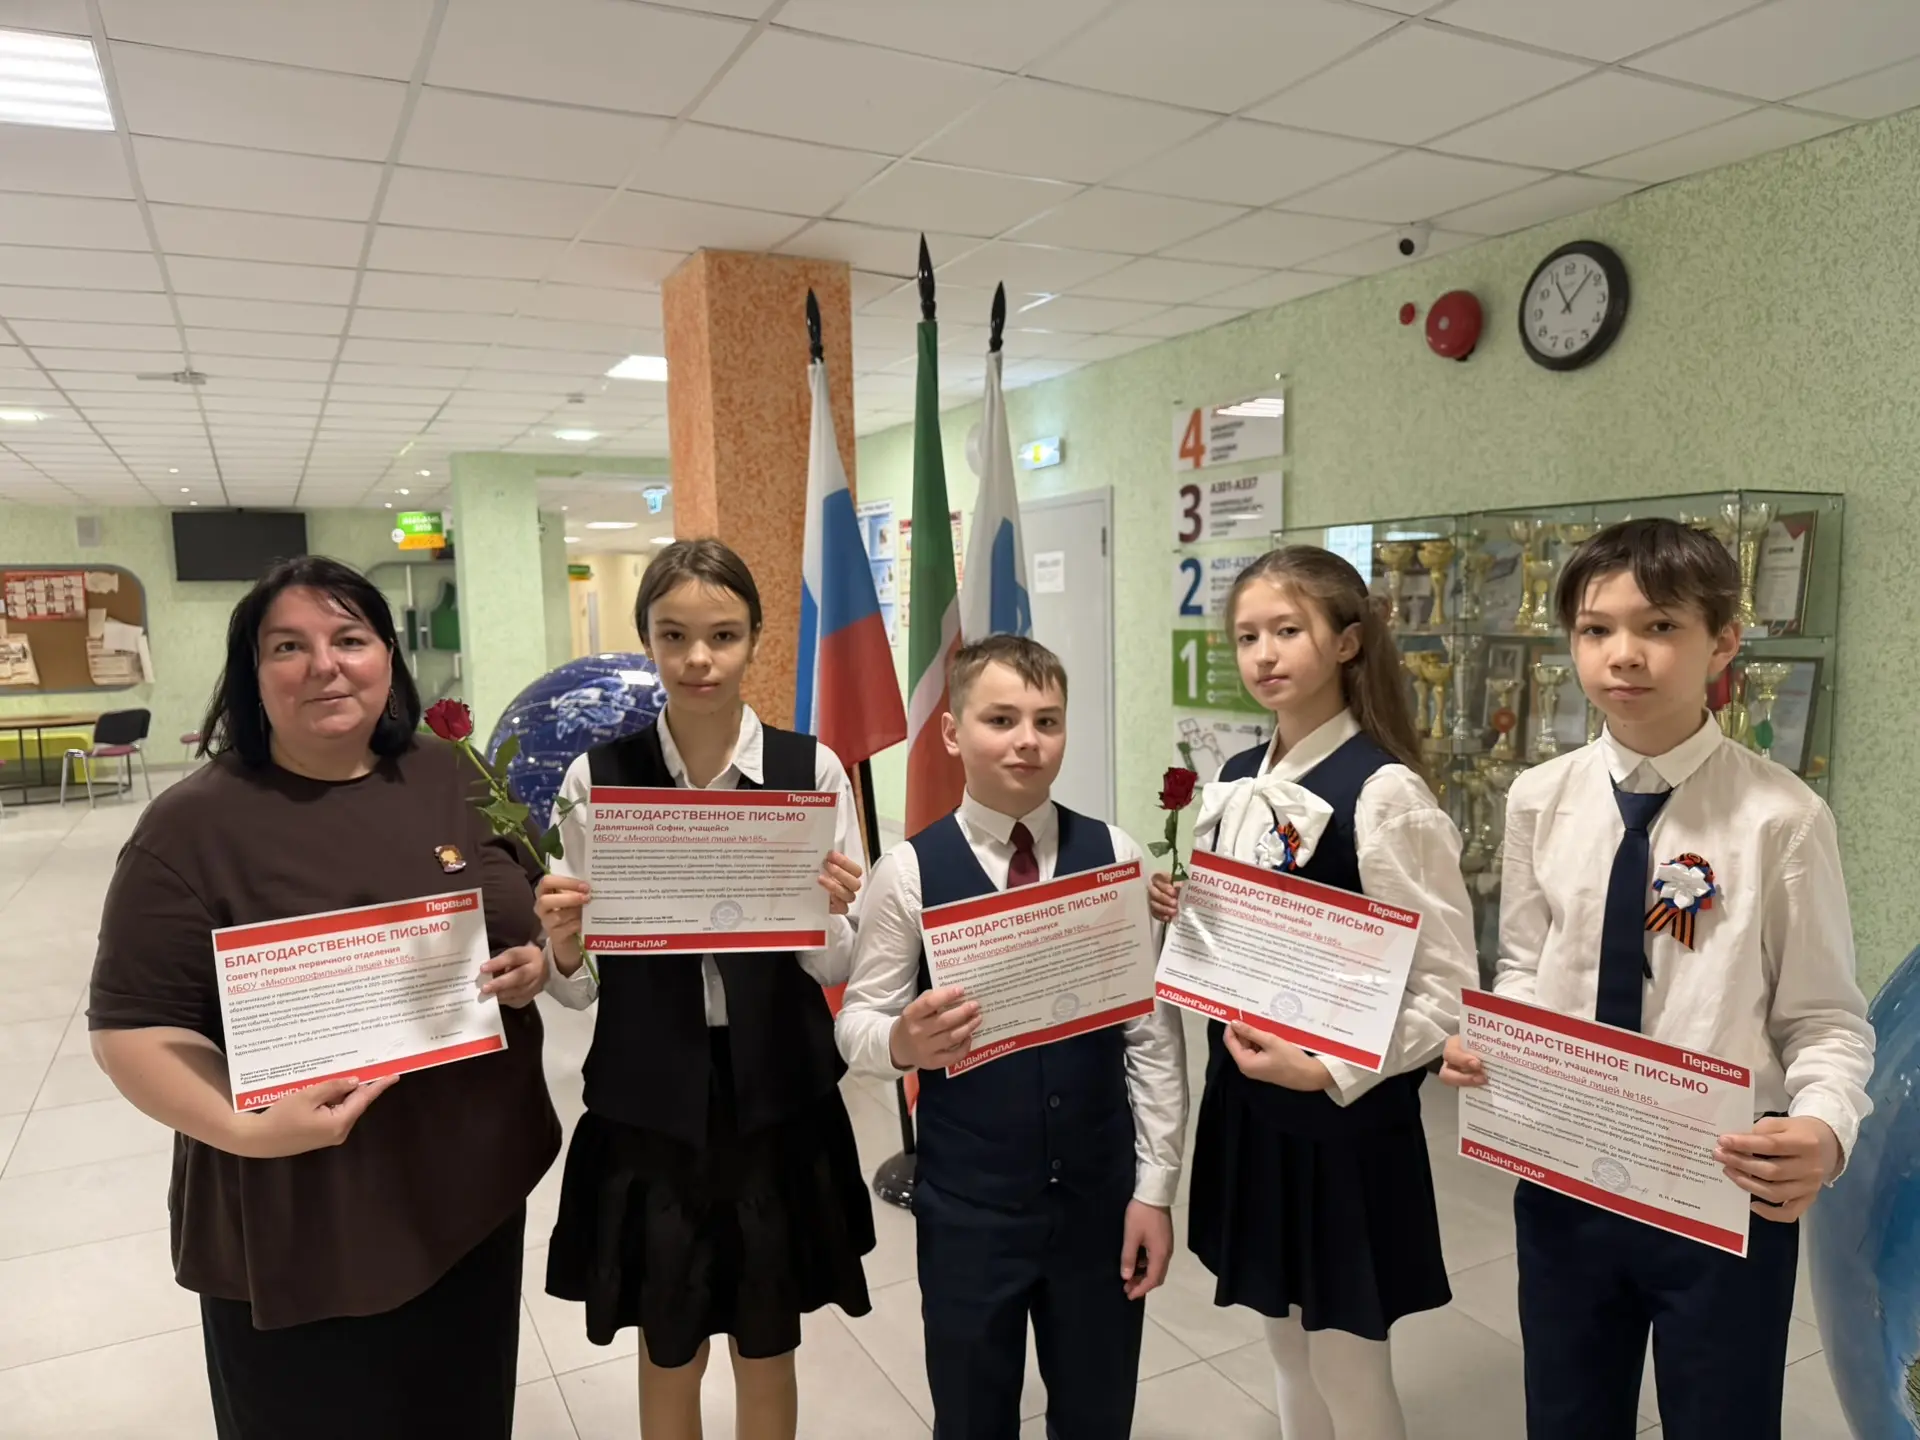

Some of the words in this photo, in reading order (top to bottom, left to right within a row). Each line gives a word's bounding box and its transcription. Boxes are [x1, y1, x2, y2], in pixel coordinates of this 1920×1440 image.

[1534, 308, 1544, 321] 9
[1538, 325, 1548, 338] 8
[1549, 335, 1559, 348] 7
[1564, 337, 1574, 350] 6
[1580, 329, 1589, 341] 5
[1179, 408, 1206, 469] 4
[1179, 484, 1202, 543] 3
[1180, 557, 1203, 616] 2
[1180, 638, 1198, 699] 1
[786, 793, 831, 804] Первые
[593, 823, 654, 832] Давлятшиной
[594, 808, 745, 821] БЛАГОДАРСТВЕННОЕ
[748, 811, 806, 821] ПИСЬМО
[593, 833, 620, 841] МБОУ
[1096, 865, 1135, 884] Первые
[425, 895, 473, 915] Первые
[1190, 870, 1325, 919] БЛАГОДАРСТВЕННОЕ
[1326, 910, 1385, 936] ПИСЬМО
[1367, 902, 1414, 925] Первые
[930, 902, 1065, 947] БЛАГОДАРСТВЕННОЕ
[1067, 889, 1118, 912] ПИСЬМО
[1273, 910, 1312, 927] учащейся
[223, 930, 386, 970] БЛАГОДАРСТВЕННОЕ
[389, 919, 451, 940] ПИСЬМО
[590, 938, 667, 949] АЛДЫНГЫЛАР
[933, 940, 977, 960] Мамыкину
[978, 930, 1016, 948] Арсению,
[1017, 921, 1058, 938] учащемуся
[225, 969, 257, 984] Совету
[260, 963, 296, 977] Первых
[298, 954, 352, 971] первичного
[353, 945, 400, 960] отделения
[227, 981, 257, 994] МБОУ
[1158, 986, 1227, 1017] АЛДЫНГЫЛАР
[953, 1039, 1016, 1071] АЛДЫНГЫЛАР
[1466, 1027, 1521, 1053] Сарсенбаеву
[1522, 1045, 1562, 1067] Дамиру,
[1564, 1059, 1618, 1083] учащемуся
[1467, 1012, 1628, 1072] БЛАГОДАРСТВЕННОЕ
[1634, 1061, 1708, 1095] ПИСЬМО
[1682, 1052, 1742, 1081] Первые
[1466, 1039, 1492, 1054] МБОУ
[1495, 1049, 1586, 1086] «Многопрофильный
[1589, 1078, 1619, 1095] лицей
[1622, 1088, 1659, 1107] №185»
[243, 1081, 318, 1107] АЛДЫНГ
[1467, 1144, 1544, 1181] АЛДЫНГЫЛАР
